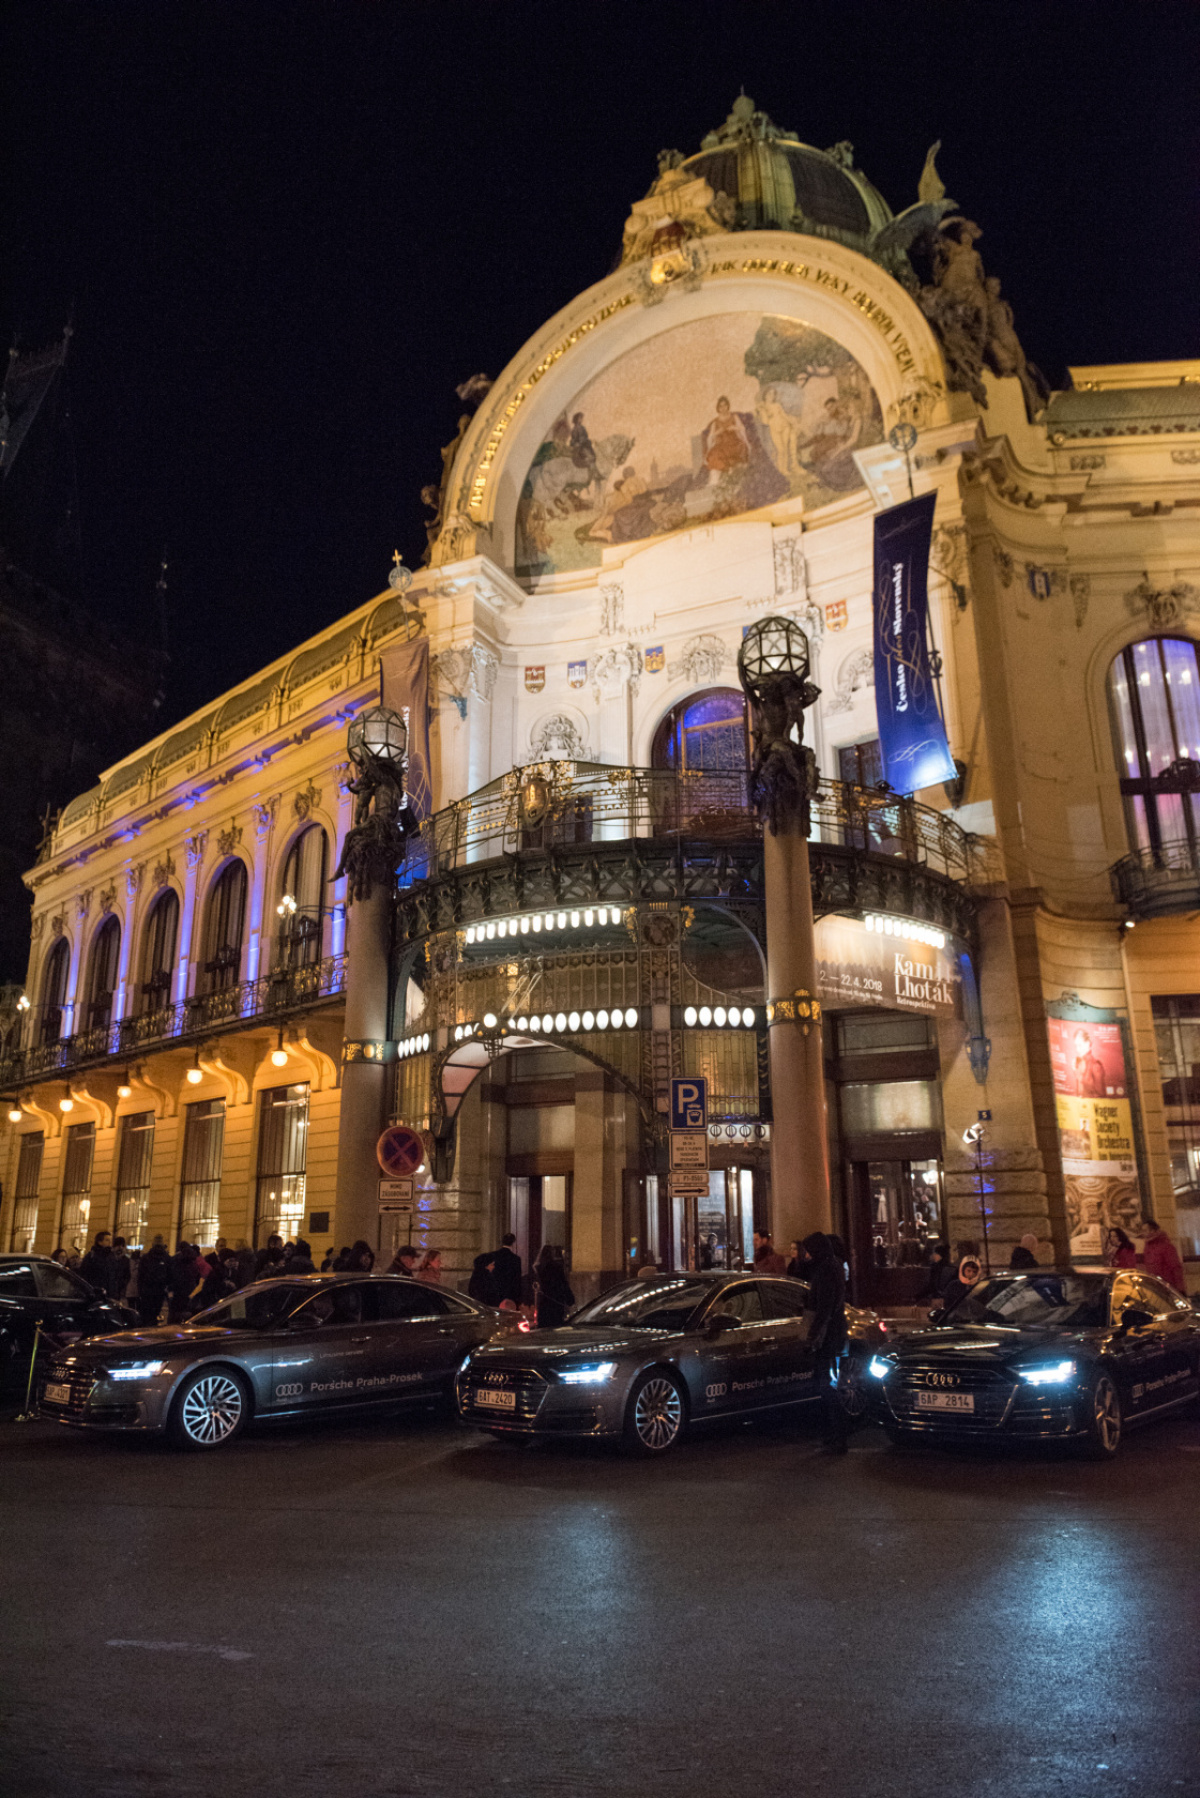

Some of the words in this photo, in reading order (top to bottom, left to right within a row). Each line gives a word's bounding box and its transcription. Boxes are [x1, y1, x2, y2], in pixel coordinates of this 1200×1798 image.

[863, 978, 882, 992] 2018
[895, 974, 954, 1004] Lhoták
[678, 1084, 699, 1113] P
[310, 1380, 353, 1392] Porsche
[356, 1372, 423, 1387] Praha-Prosek
[732, 1379, 765, 1391] Porsche
[479, 1392, 490, 1401] 6AT
[495, 1393, 512, 1404] 2420
[921, 1394, 938, 1404] 6AP
[945, 1396, 969, 1406] 2814
